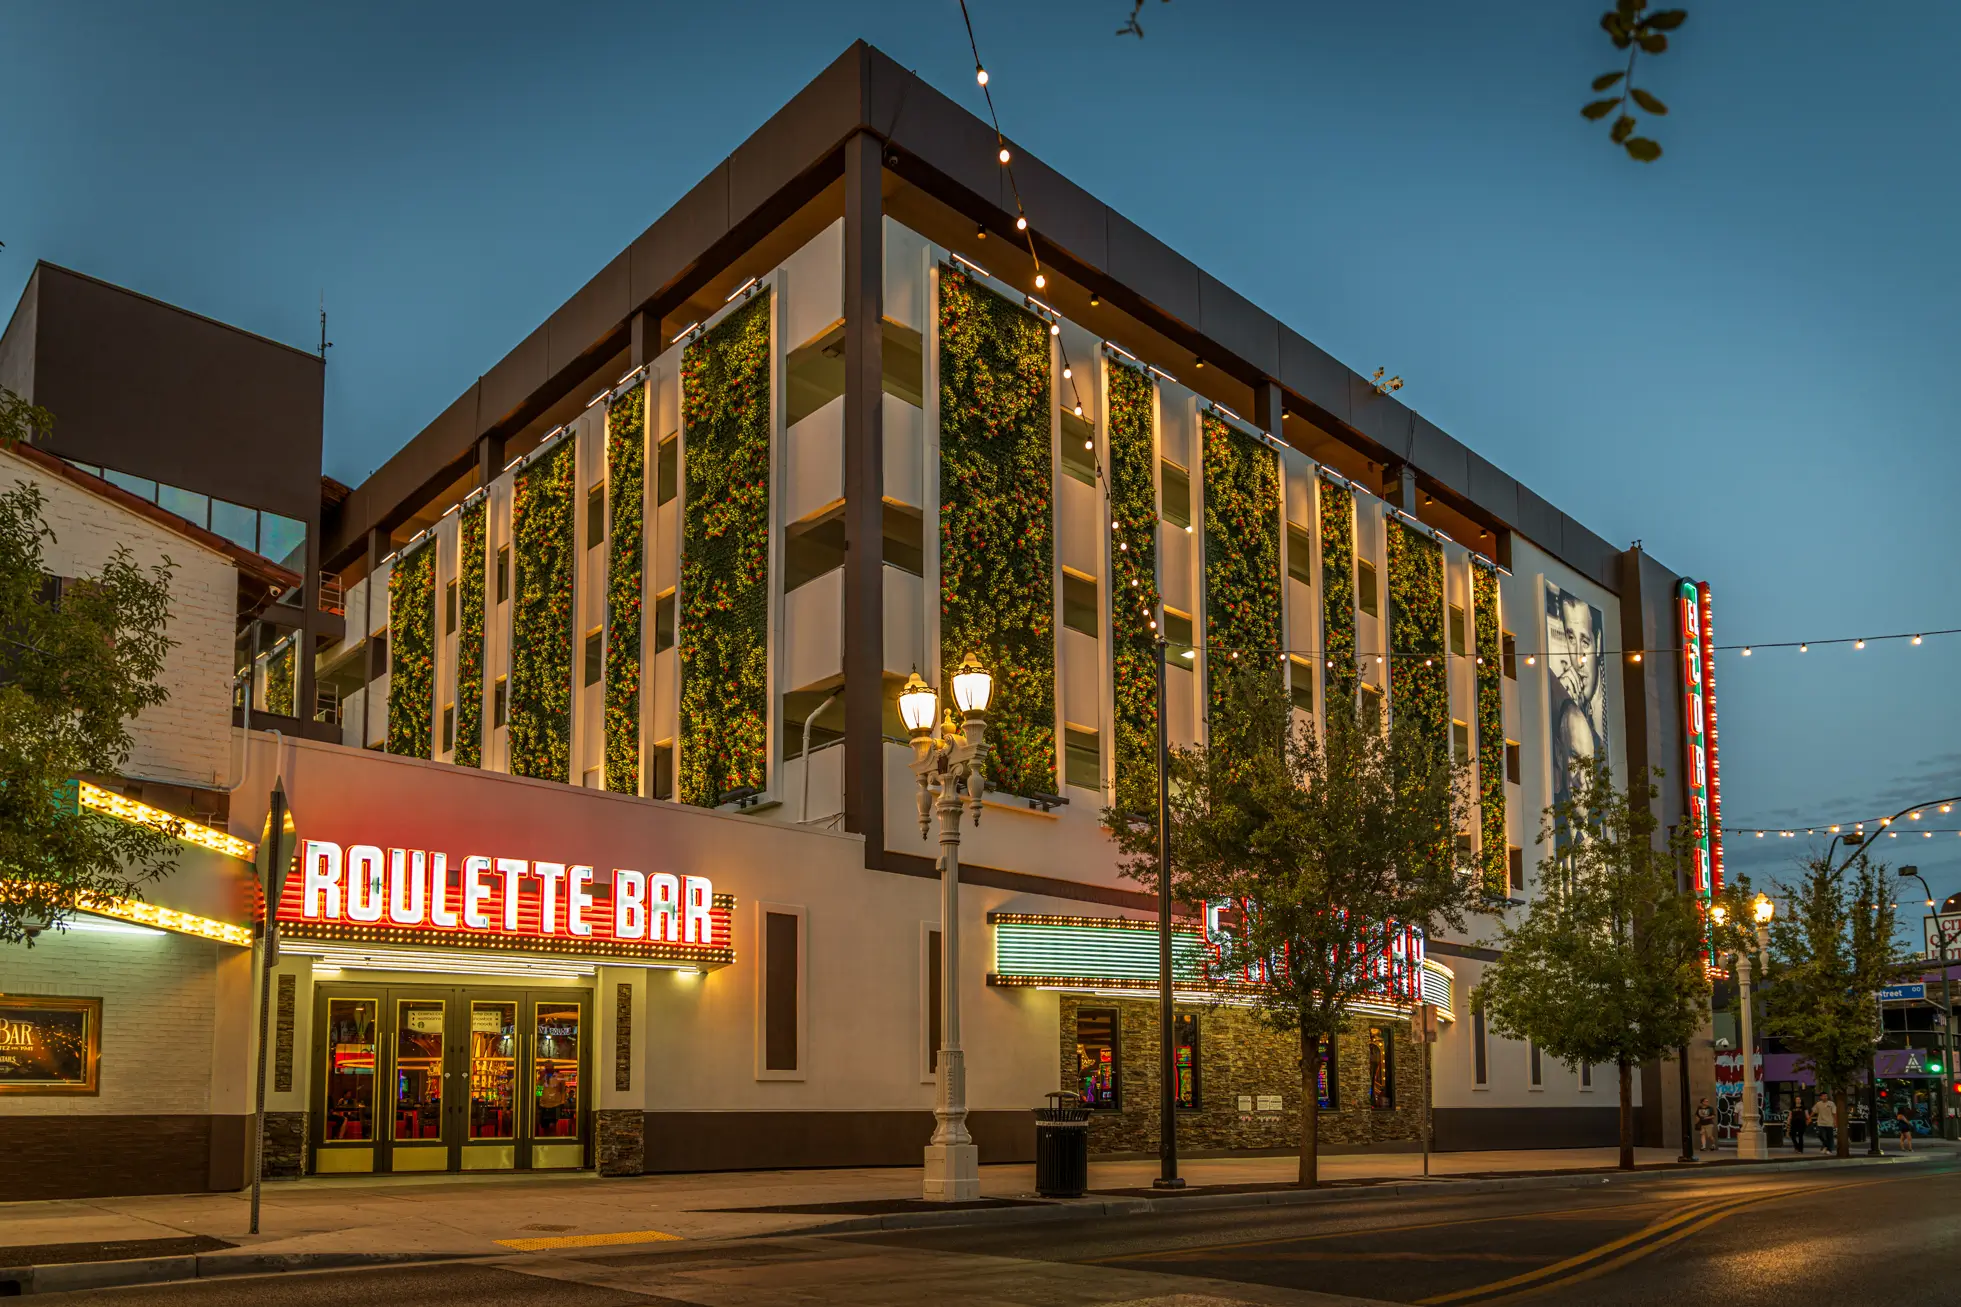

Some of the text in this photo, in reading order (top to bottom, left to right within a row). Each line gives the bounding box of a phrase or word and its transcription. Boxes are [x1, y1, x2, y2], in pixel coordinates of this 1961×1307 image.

[302, 839, 713, 946] ROULETTE BAR
[0, 1018, 34, 1045] BAR
